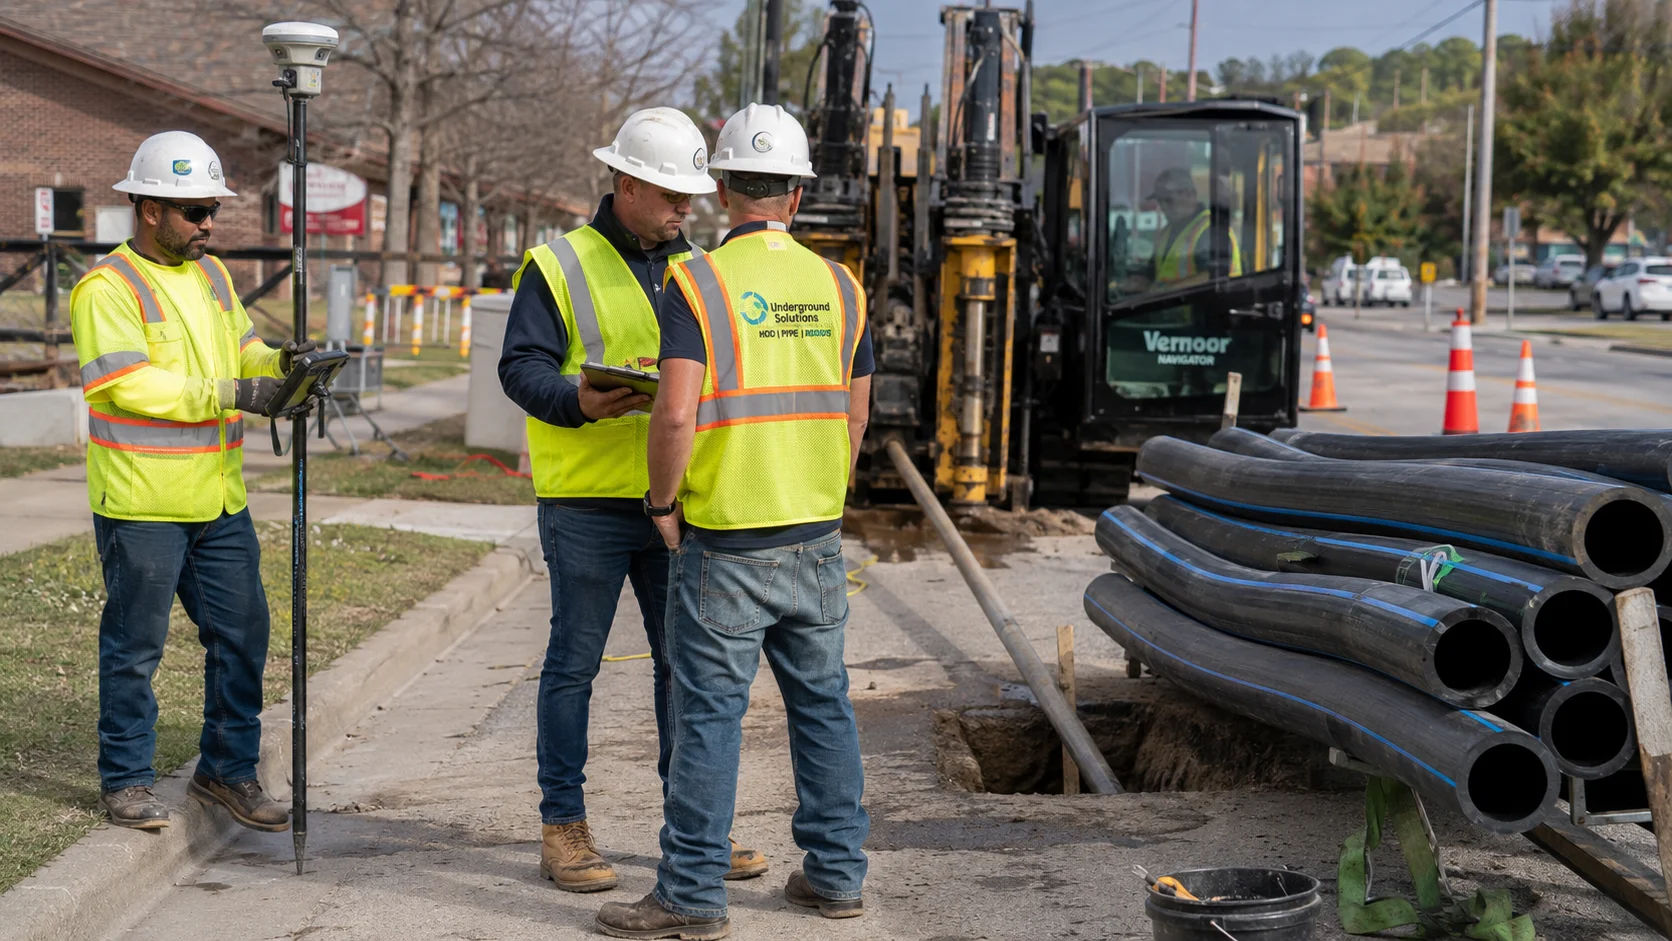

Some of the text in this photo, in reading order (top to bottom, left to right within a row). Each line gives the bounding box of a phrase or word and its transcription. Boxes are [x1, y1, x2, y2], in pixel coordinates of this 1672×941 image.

[770, 302, 831, 314] Underground
[774, 313, 819, 323] Solutions
[1157, 354, 1215, 365] NAVIGATOR
